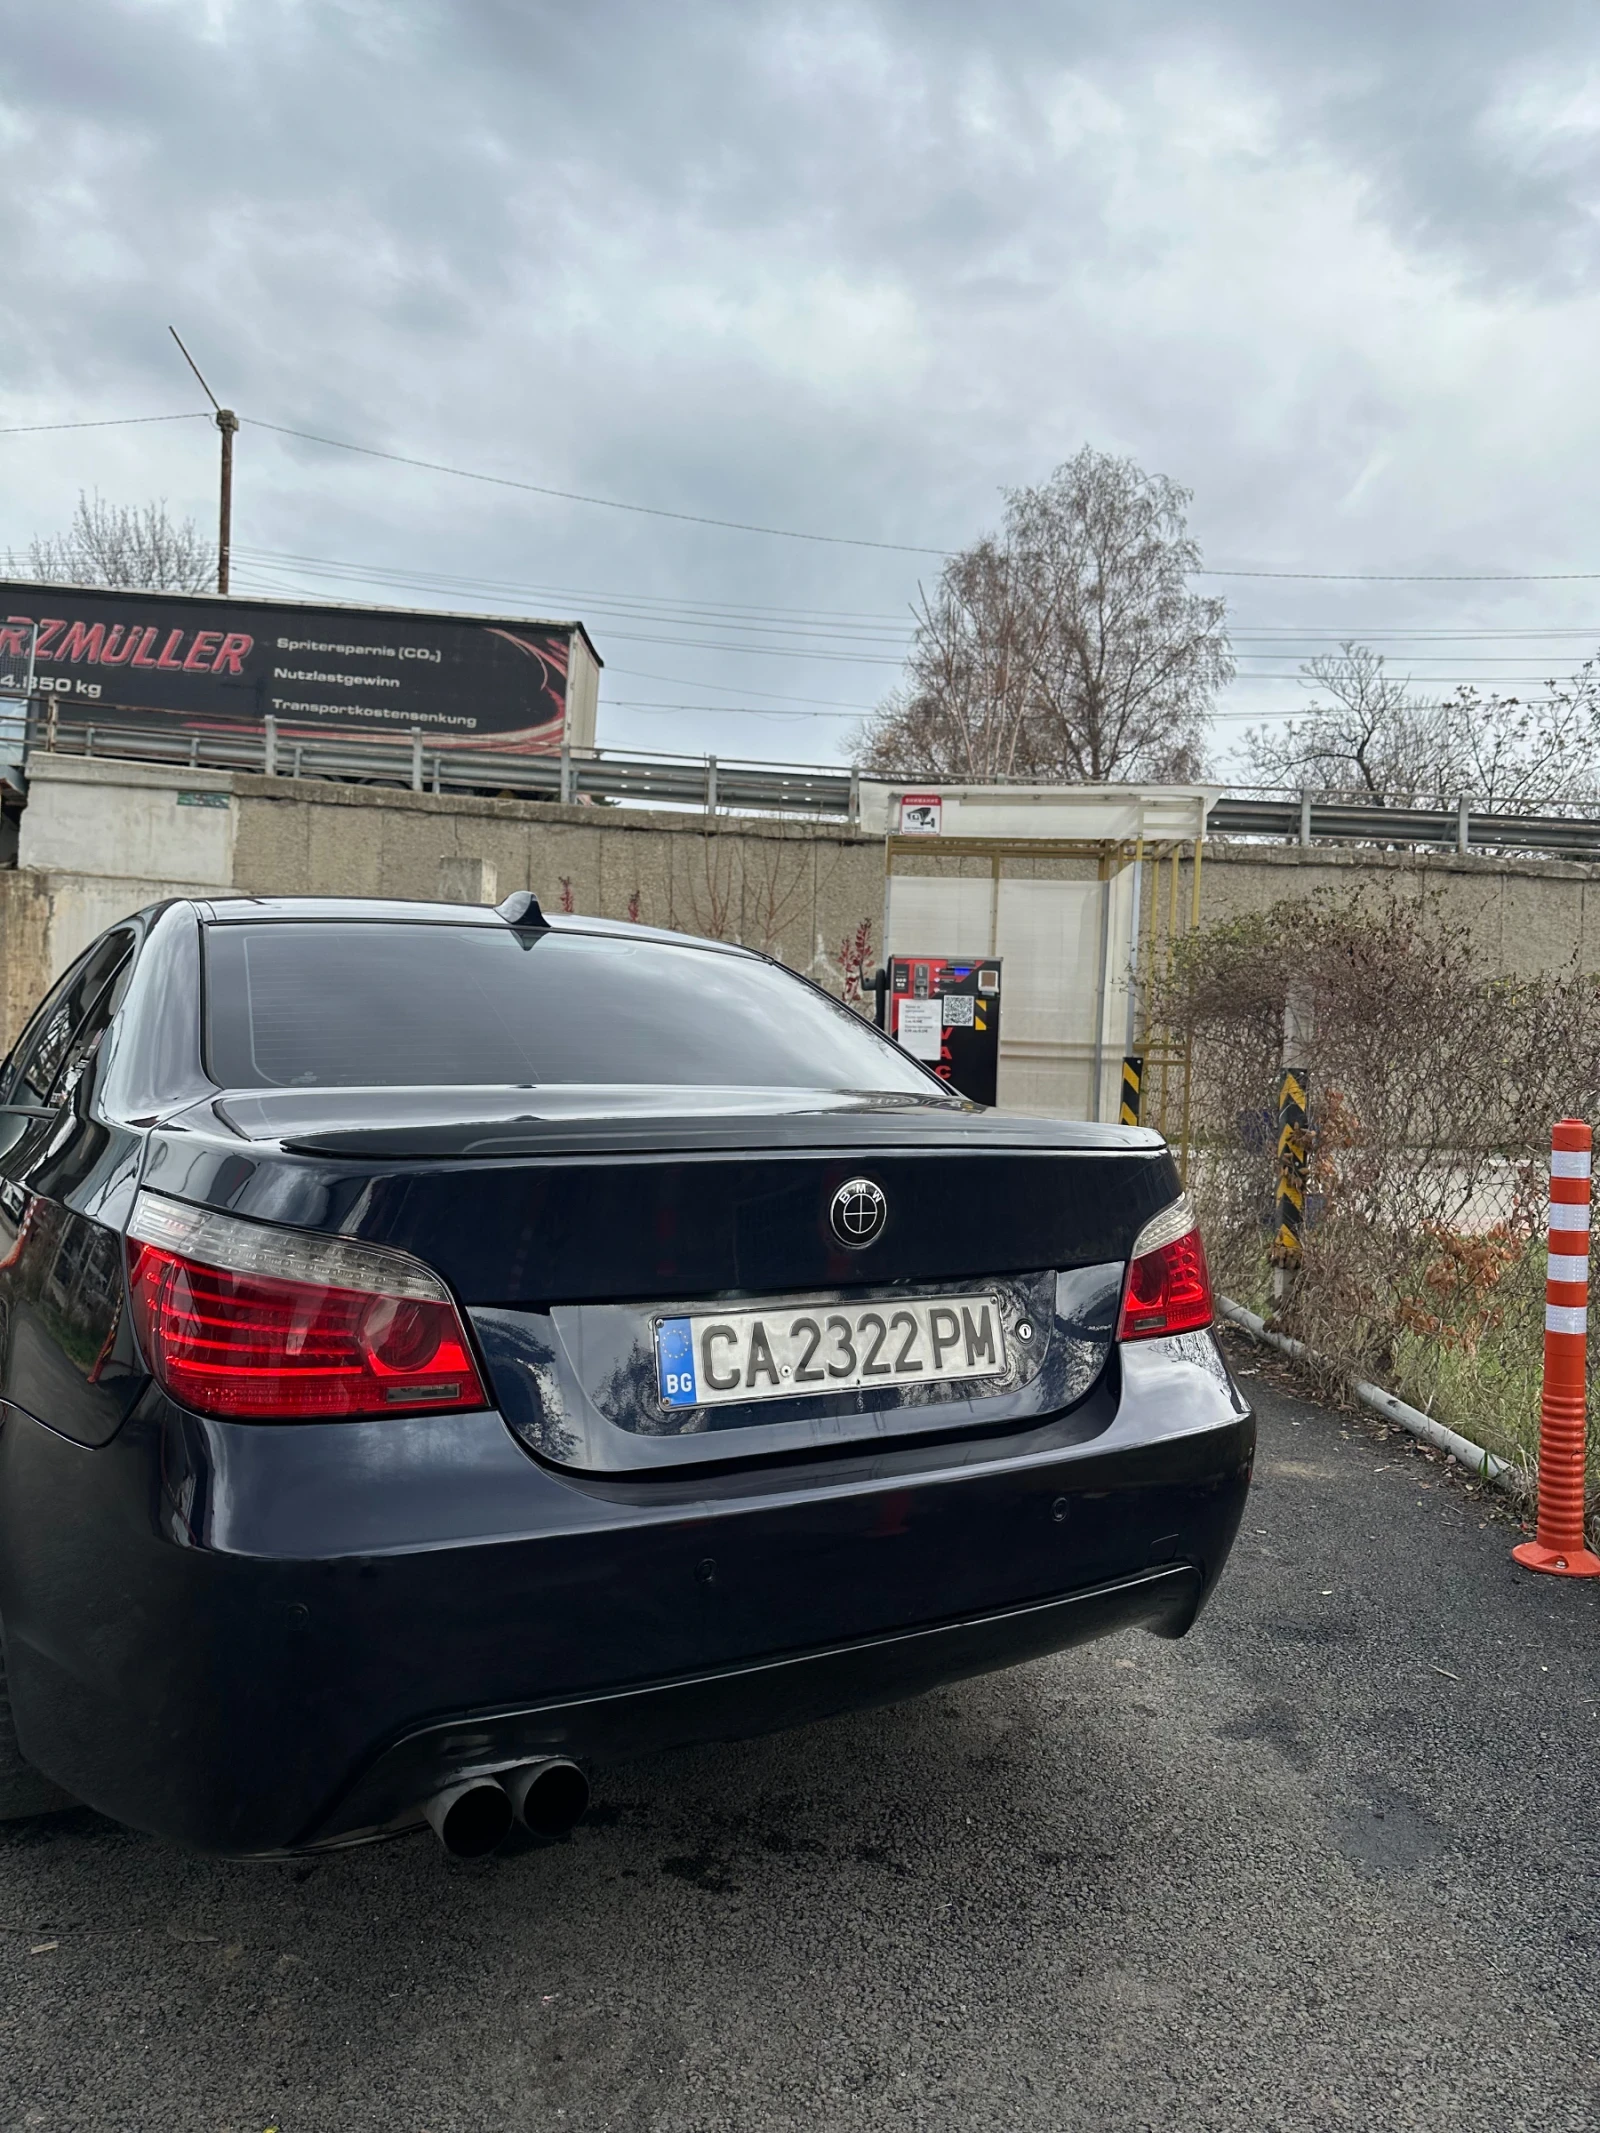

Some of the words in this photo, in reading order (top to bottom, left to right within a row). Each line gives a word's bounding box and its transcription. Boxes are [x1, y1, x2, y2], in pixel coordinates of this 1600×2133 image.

[276, 637, 396, 658] Spritersparnis
[75, 677, 102, 698] kg
[273, 667, 400, 687] Nutzlastgewinn
[271, 698, 477, 729] Transportkostensenkung
[838, 1183, 882, 1204] BMW
[666, 1372, 693, 1394] BG
